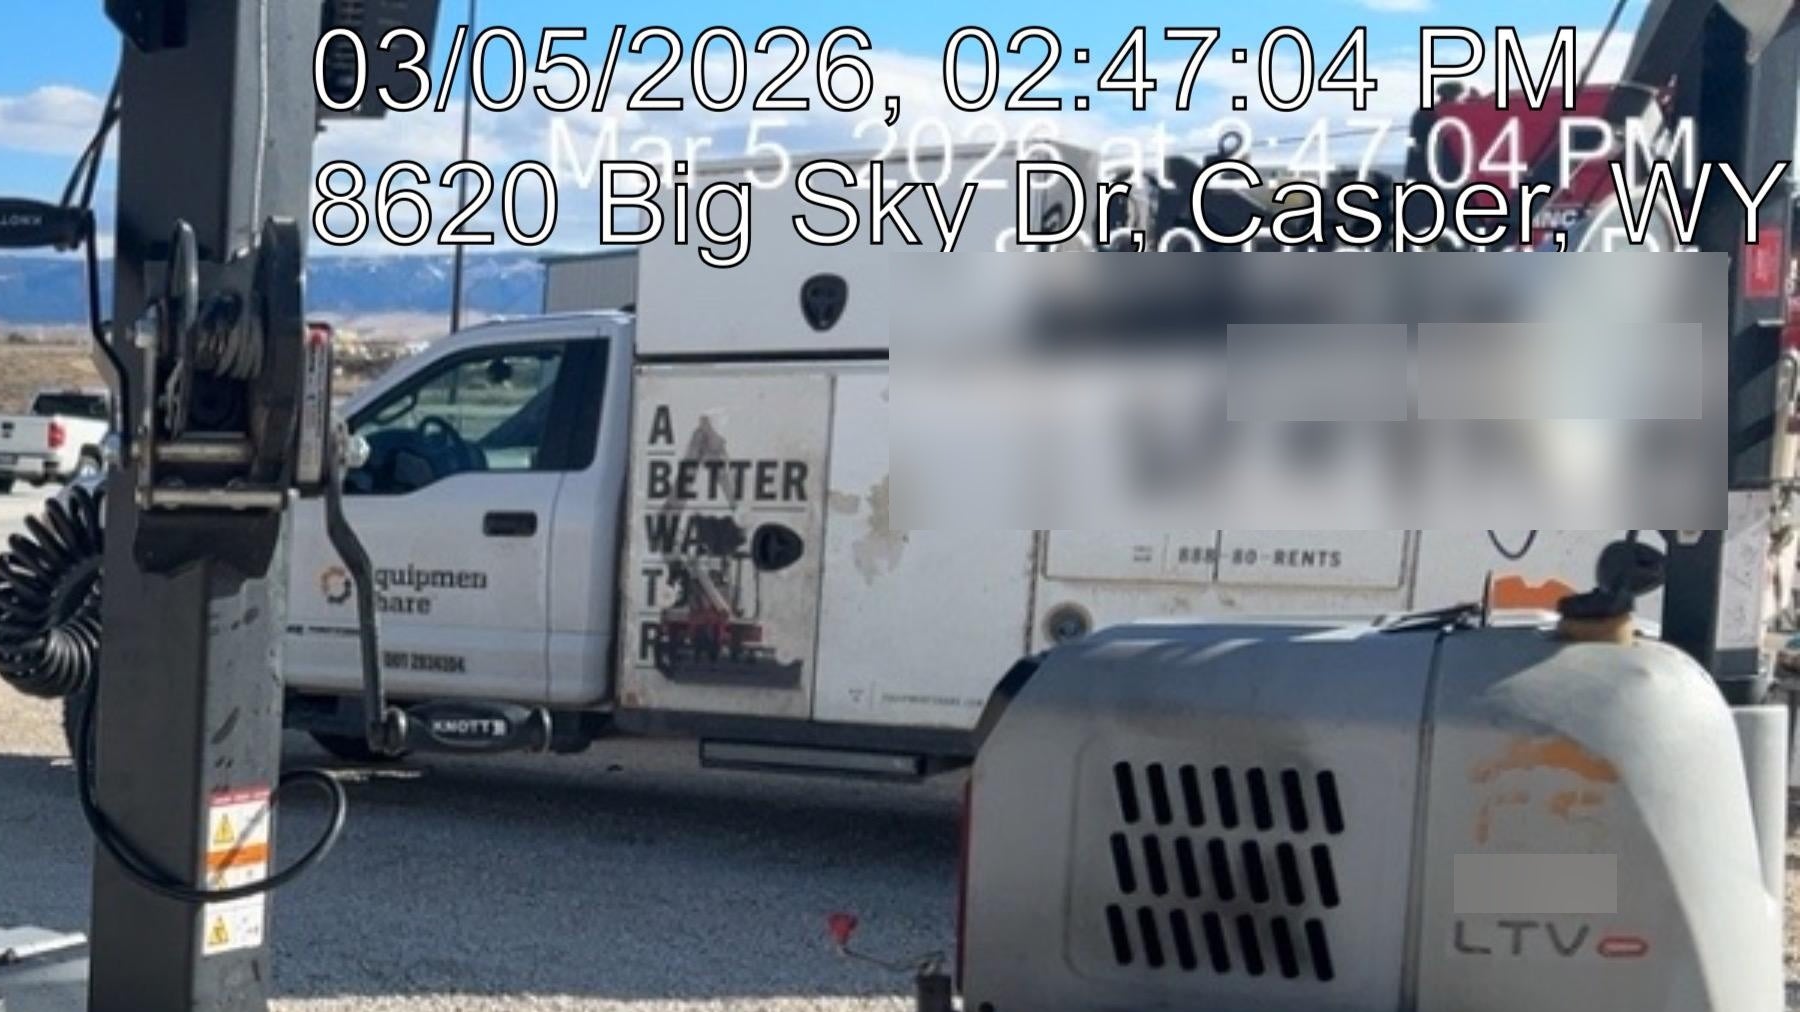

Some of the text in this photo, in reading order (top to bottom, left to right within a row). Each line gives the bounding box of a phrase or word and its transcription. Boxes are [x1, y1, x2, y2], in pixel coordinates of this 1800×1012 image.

[649, 405, 674, 445] A
[648, 461, 808, 500] BETTER
[432, 719, 490, 734] KNOTT
